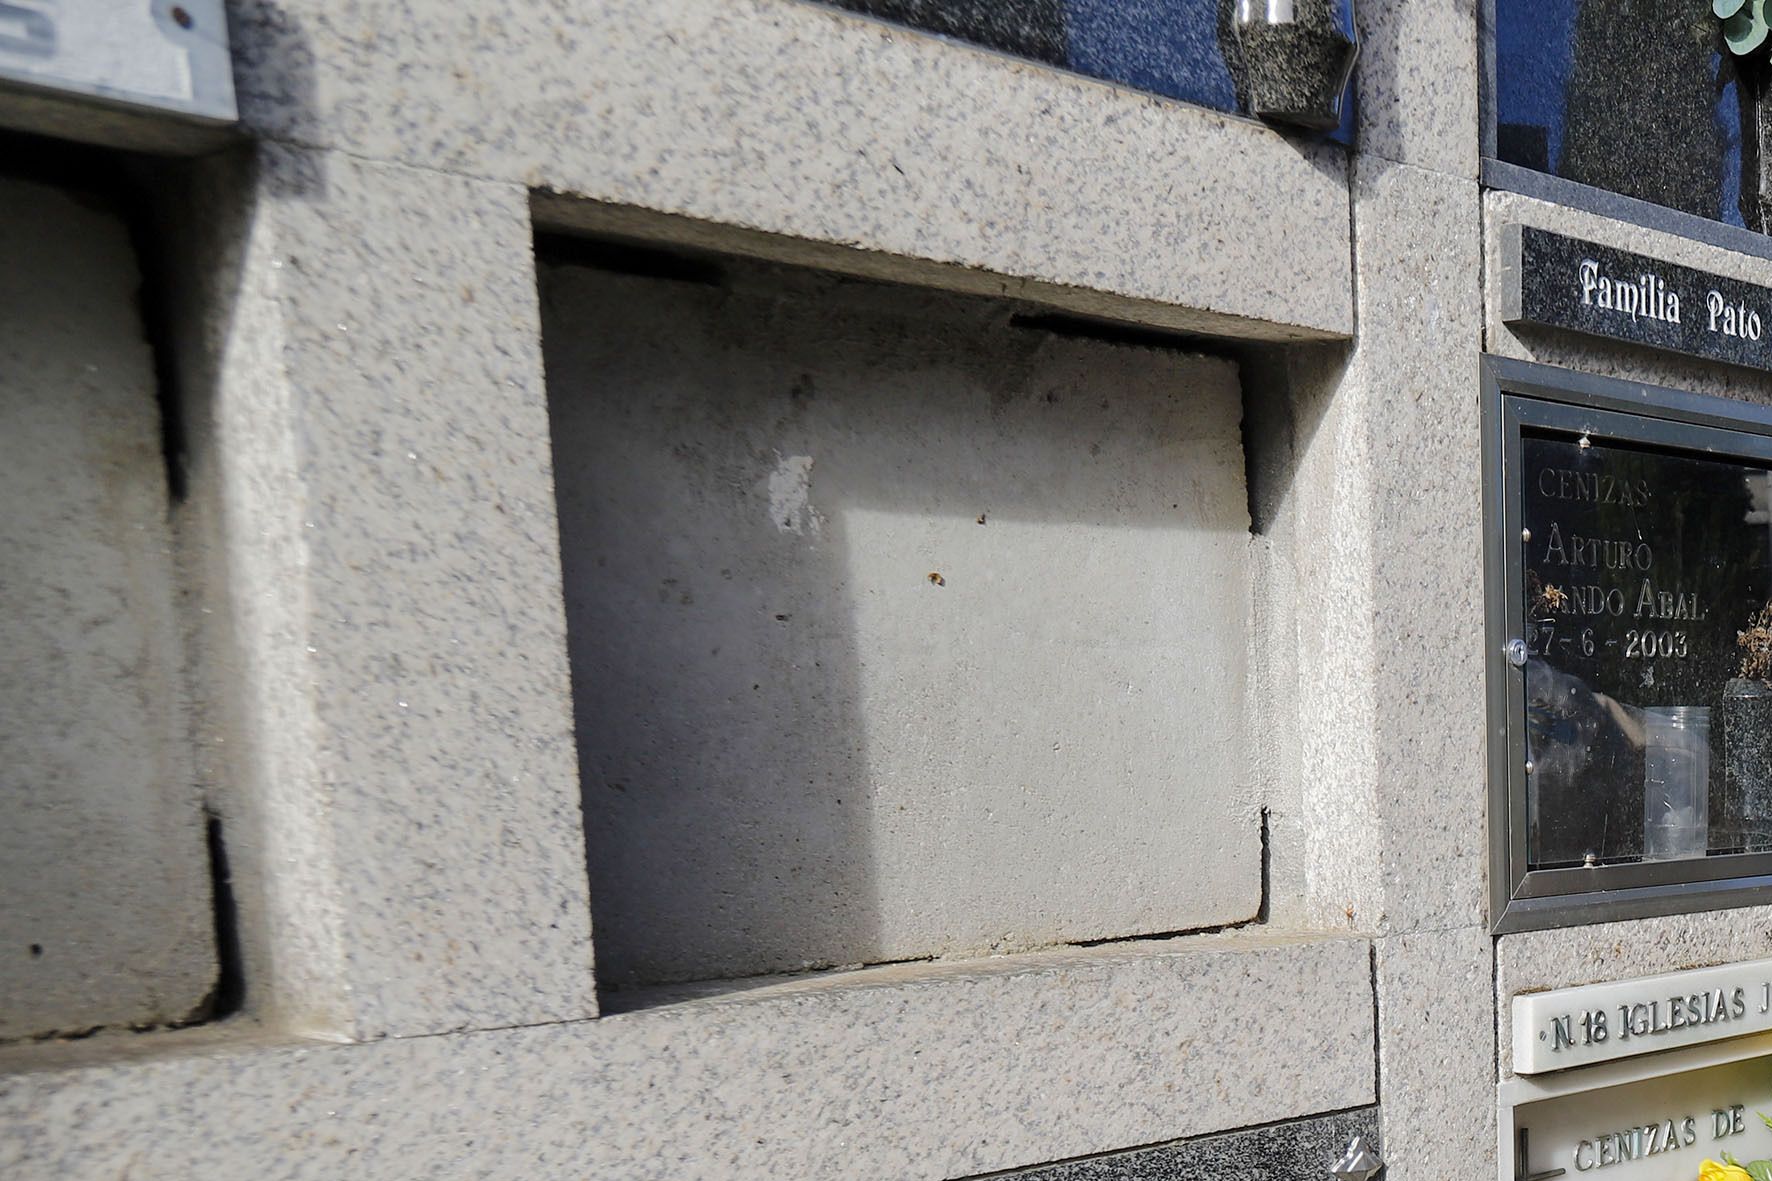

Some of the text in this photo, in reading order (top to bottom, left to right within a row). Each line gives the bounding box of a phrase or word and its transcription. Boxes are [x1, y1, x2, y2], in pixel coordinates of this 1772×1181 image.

[1579, 259, 1681, 324] Familia
[1707, 290, 1761, 341] Pato
[1539, 467, 1651, 507] CENIZAS
[1616, 986, 1746, 1039] IGLESIAS
[1574, 1103, 1745, 1172] CENIZAS DE
